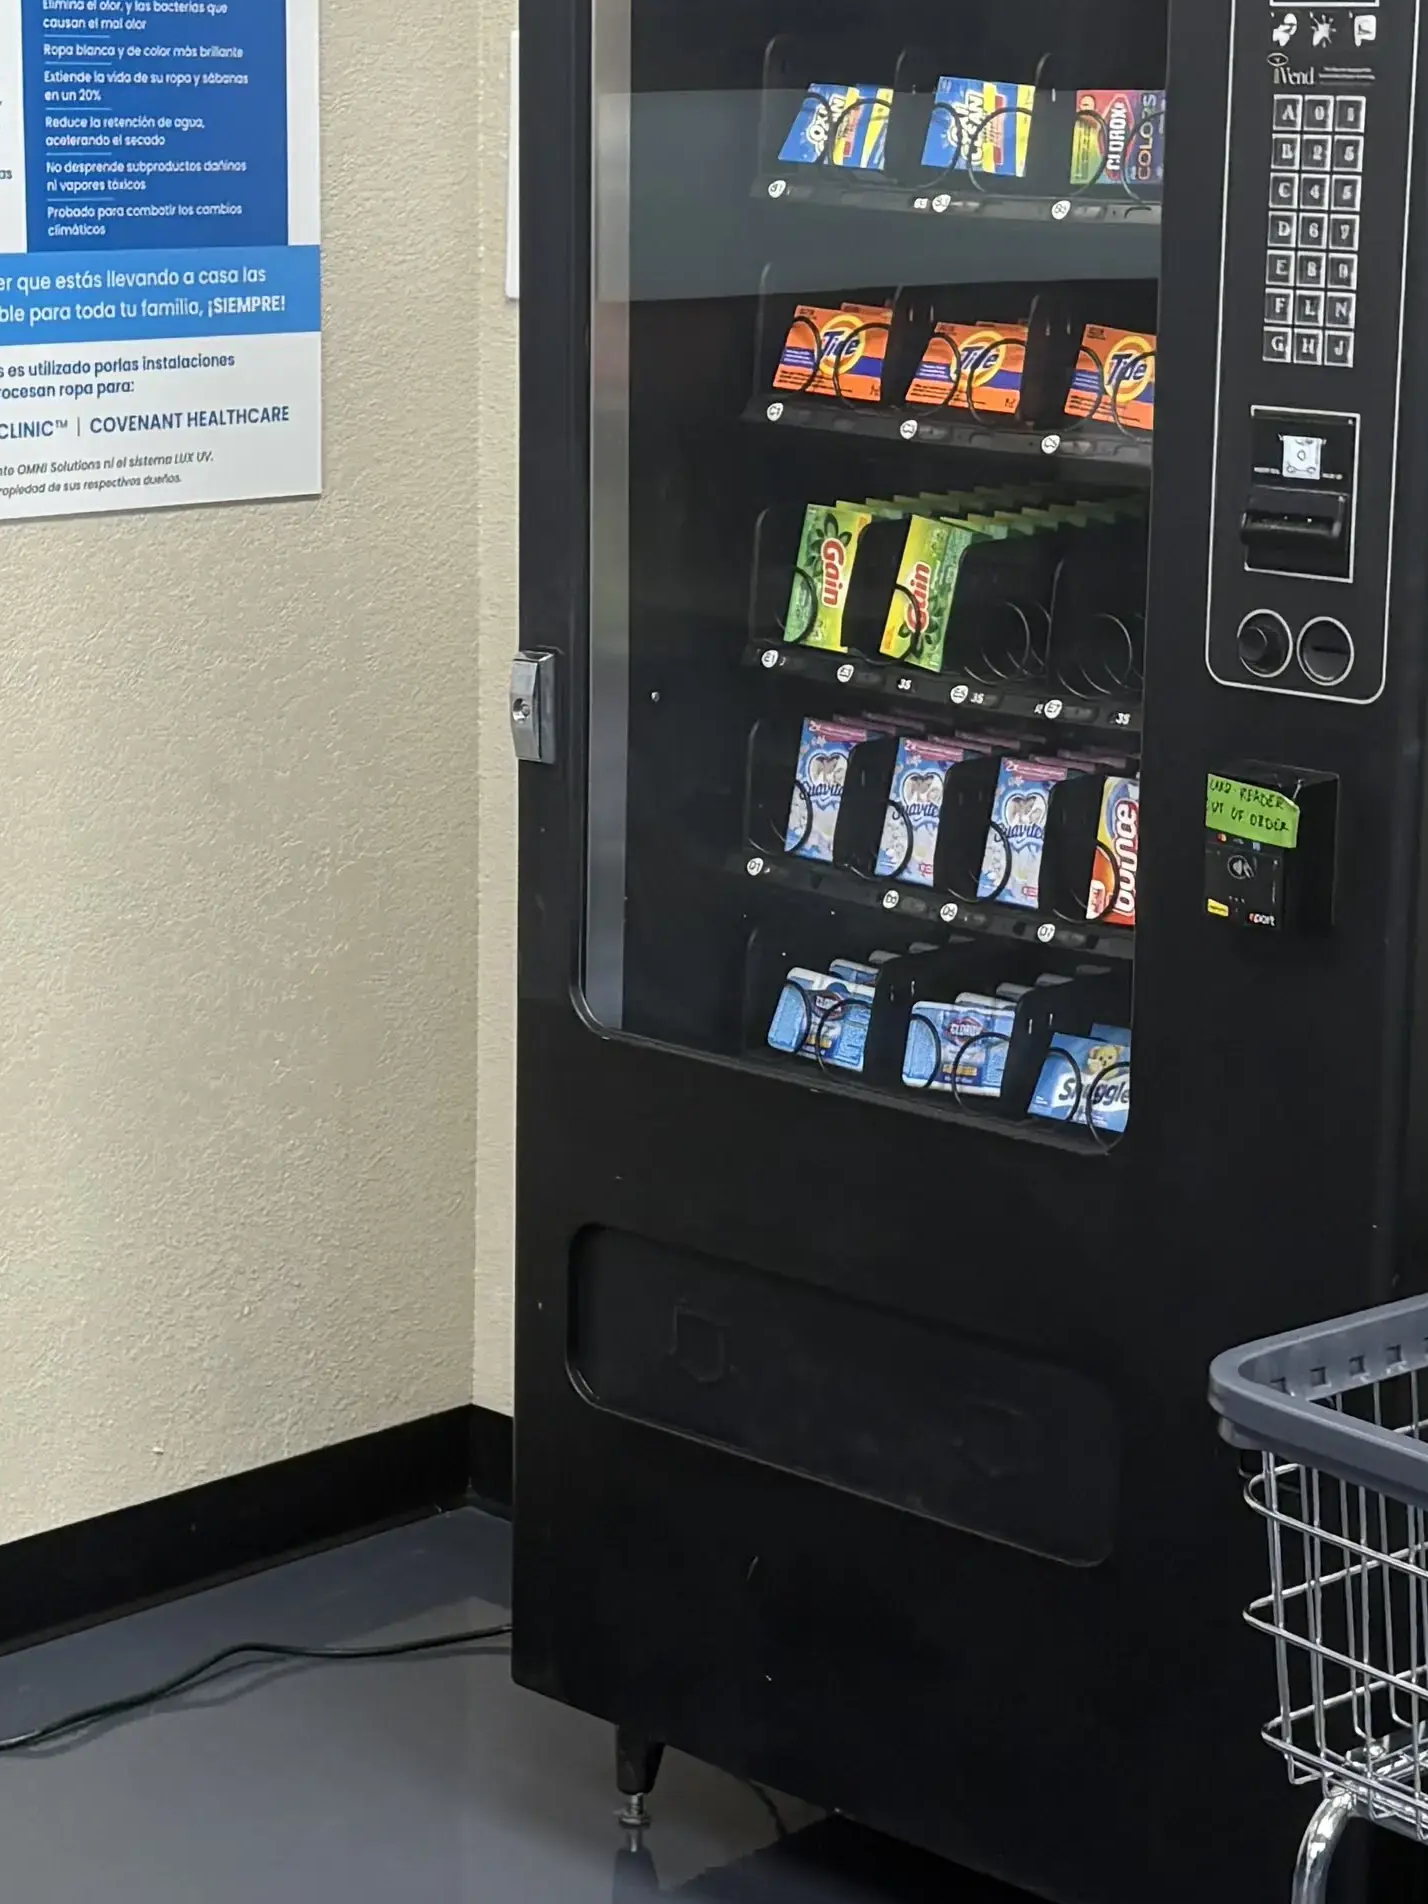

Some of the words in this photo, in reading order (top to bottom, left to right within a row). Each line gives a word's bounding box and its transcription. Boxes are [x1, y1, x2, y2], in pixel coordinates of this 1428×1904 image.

[42, 18, 86, 29] causan
[87, 17, 98, 29] el
[100, 17, 123, 29] mal
[124, 17, 146, 30] olor
[1282, 104, 1296, 121] A
[1278, 182, 1291, 198] C
[1278, 220, 1291, 236] D
[1276, 259, 1288, 275] E
[16, 275, 51, 296] que
[55, 270, 102, 289] estás
[106, 268, 179, 287] llevando
[182, 271, 194, 285] a
[198, 269, 238, 284] casa
[242, 266, 266, 282] las
[29, 306, 71, 327] para
[75, 301, 115, 319] toda
[119, 302, 136, 317] tu
[141, 297, 203, 316] familia,
[207, 295, 285, 317] ¡SIEMPRE!
[1275, 297, 1286, 313] F
[1305, 299, 1316, 315] L
[1335, 301, 1348, 318] N
[1271, 336, 1284, 351] G
[1302, 337, 1315, 354] H
[1334, 339, 1344, 356] J
[89, 412, 183, 433] COVENANT
[186, 405, 289, 427] HEALTHCARE
[823, 540, 844, 606] Gain
